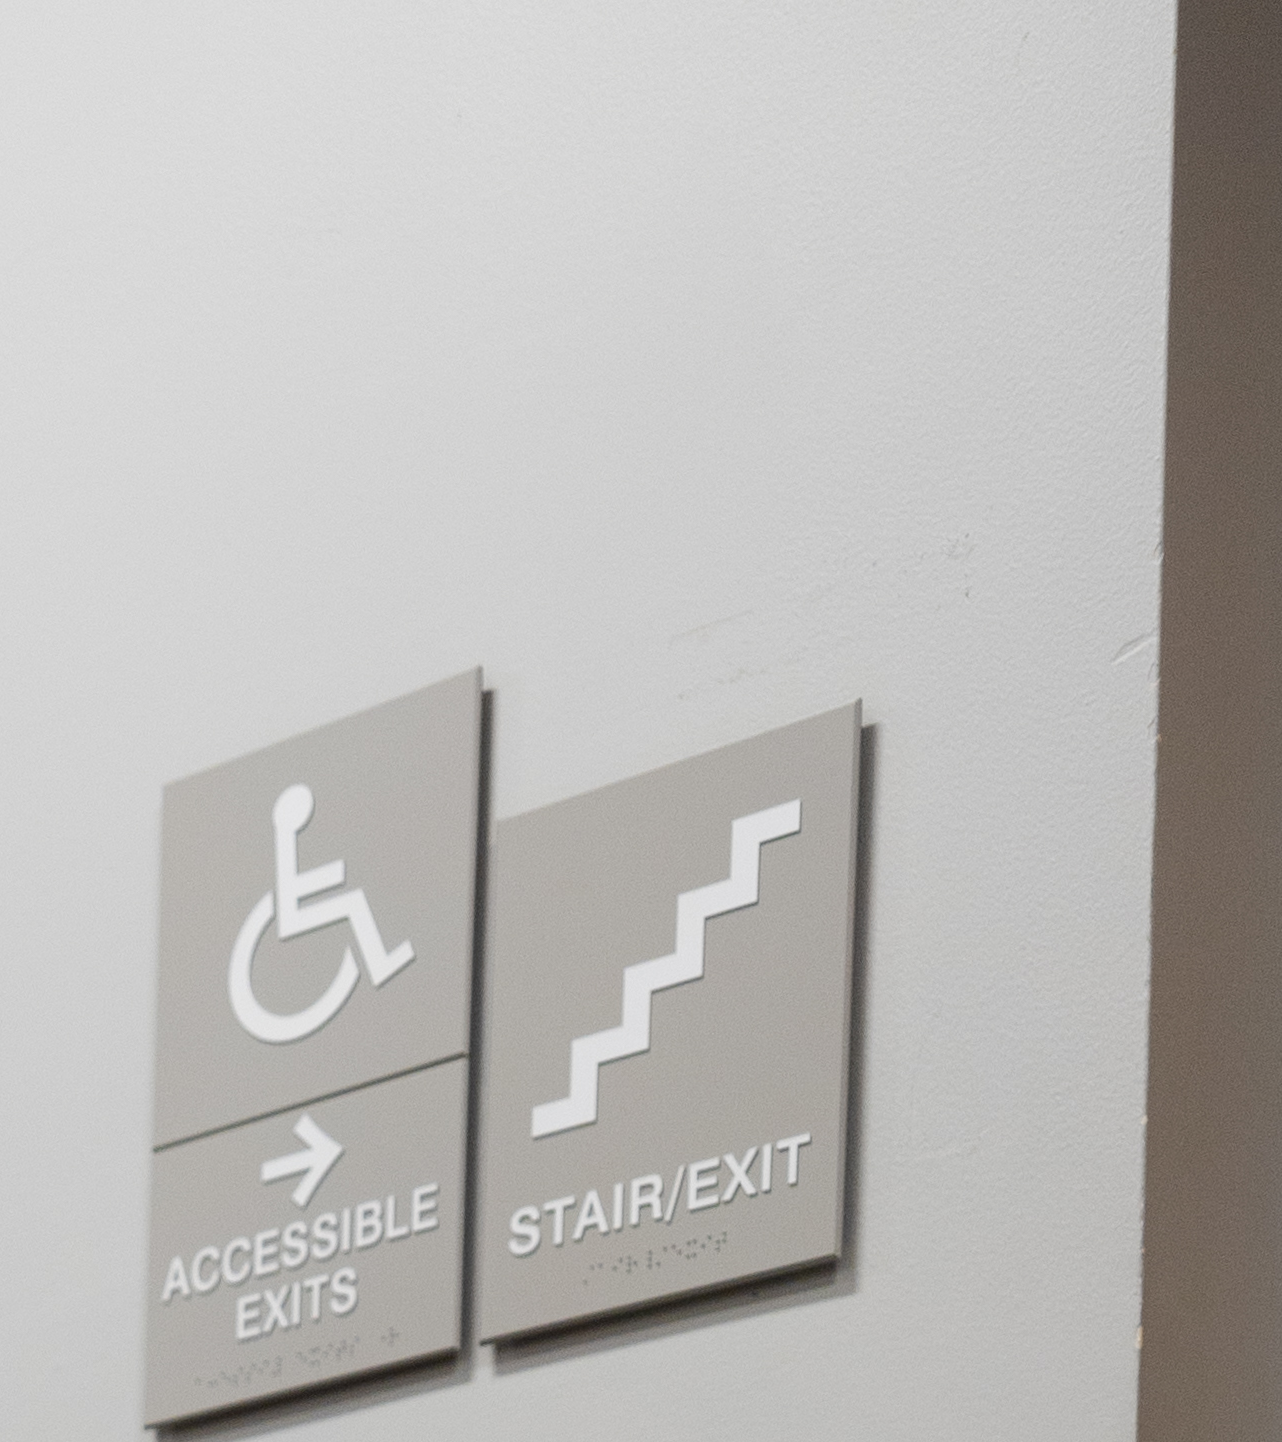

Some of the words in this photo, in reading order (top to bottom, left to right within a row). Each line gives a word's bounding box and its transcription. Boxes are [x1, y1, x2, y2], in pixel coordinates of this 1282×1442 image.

[161, 1183, 439, 1302] ACCESSIBLE
[508, 1133, 811, 1256] STAIR/EXIT
[236, 1268, 358, 1341] EXITS
